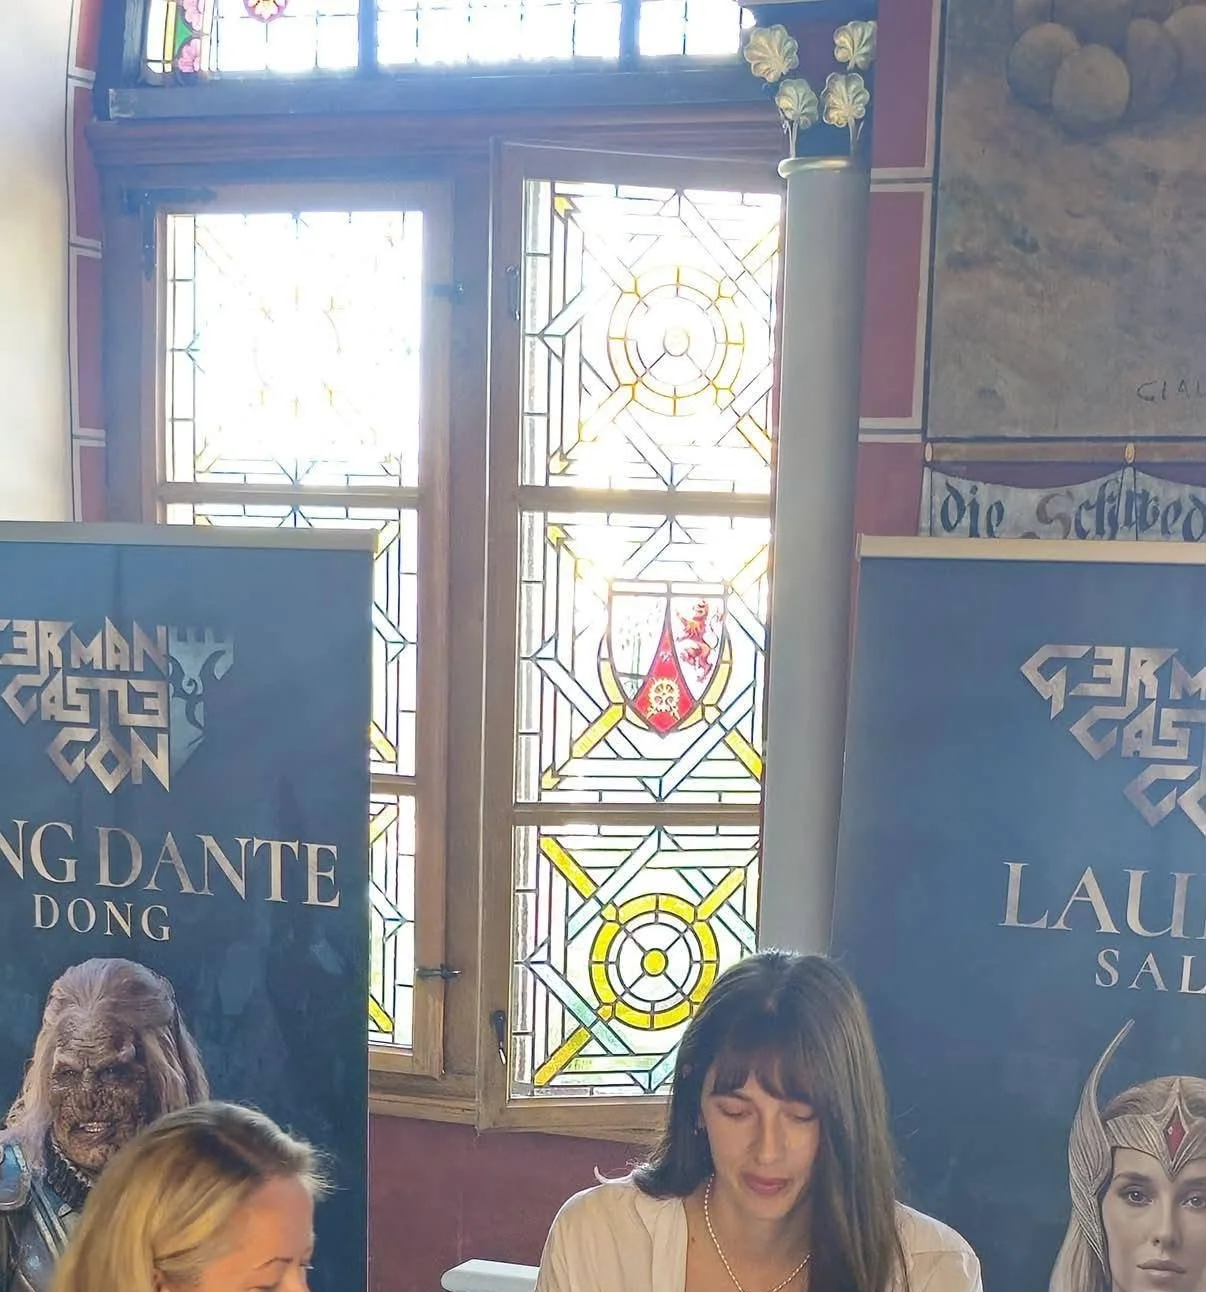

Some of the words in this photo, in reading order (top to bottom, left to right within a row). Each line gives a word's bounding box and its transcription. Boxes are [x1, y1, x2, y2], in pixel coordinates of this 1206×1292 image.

[940, 478, 1005, 539] die
[0, 616, 170, 680] ERMAN
[48, 727, 170, 794] CON
[95, 826, 341, 908] DANTE
[32, 893, 171, 942] DONG
[997, 861, 1206, 940] LAU
